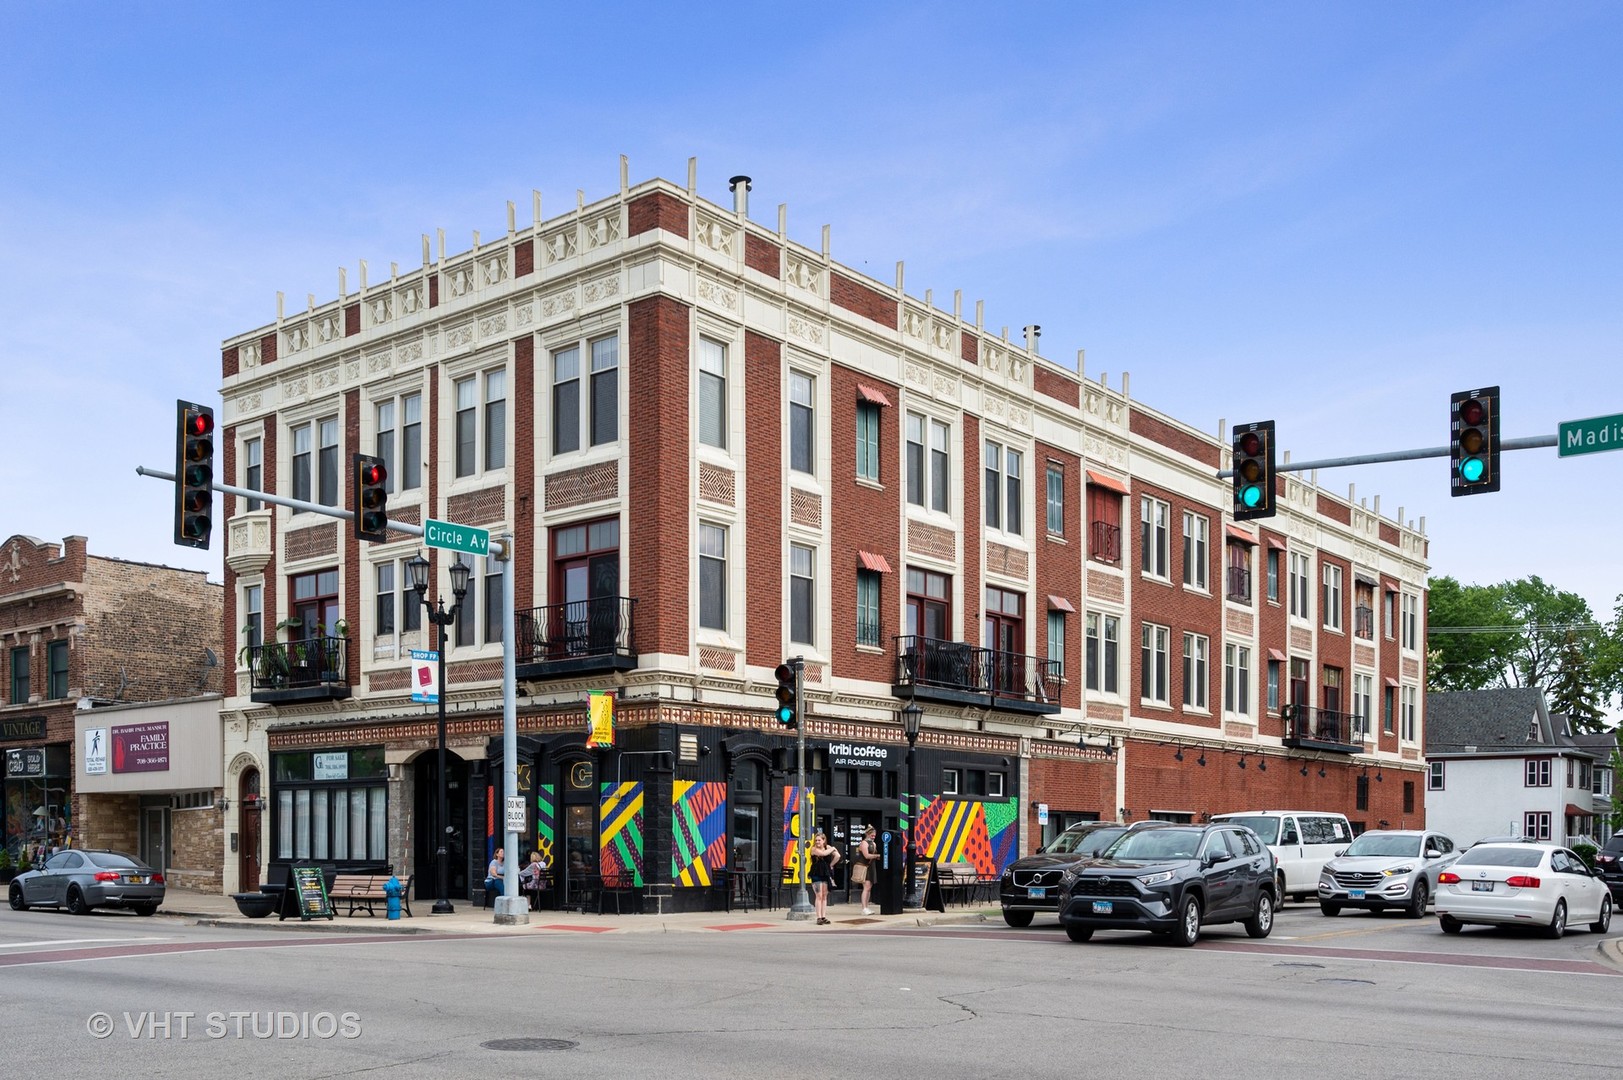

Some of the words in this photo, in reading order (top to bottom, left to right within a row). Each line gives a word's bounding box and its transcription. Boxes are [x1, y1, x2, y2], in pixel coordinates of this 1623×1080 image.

[428, 526, 463, 545] Circle
[470, 534, 487, 549] Av
[3, 721, 40, 736] VINTAGE
[140, 733, 167, 743] FAMILY
[130, 741, 167, 752] PRACTICE
[829, 742, 852, 756] kribi
[853, 745, 888, 758] coffee
[847, 759, 882, 767] ROASTERS
[508, 800, 515, 808] DO
[515, 800, 525, 808] NOT
[508, 811, 525, 820] BLOCK
